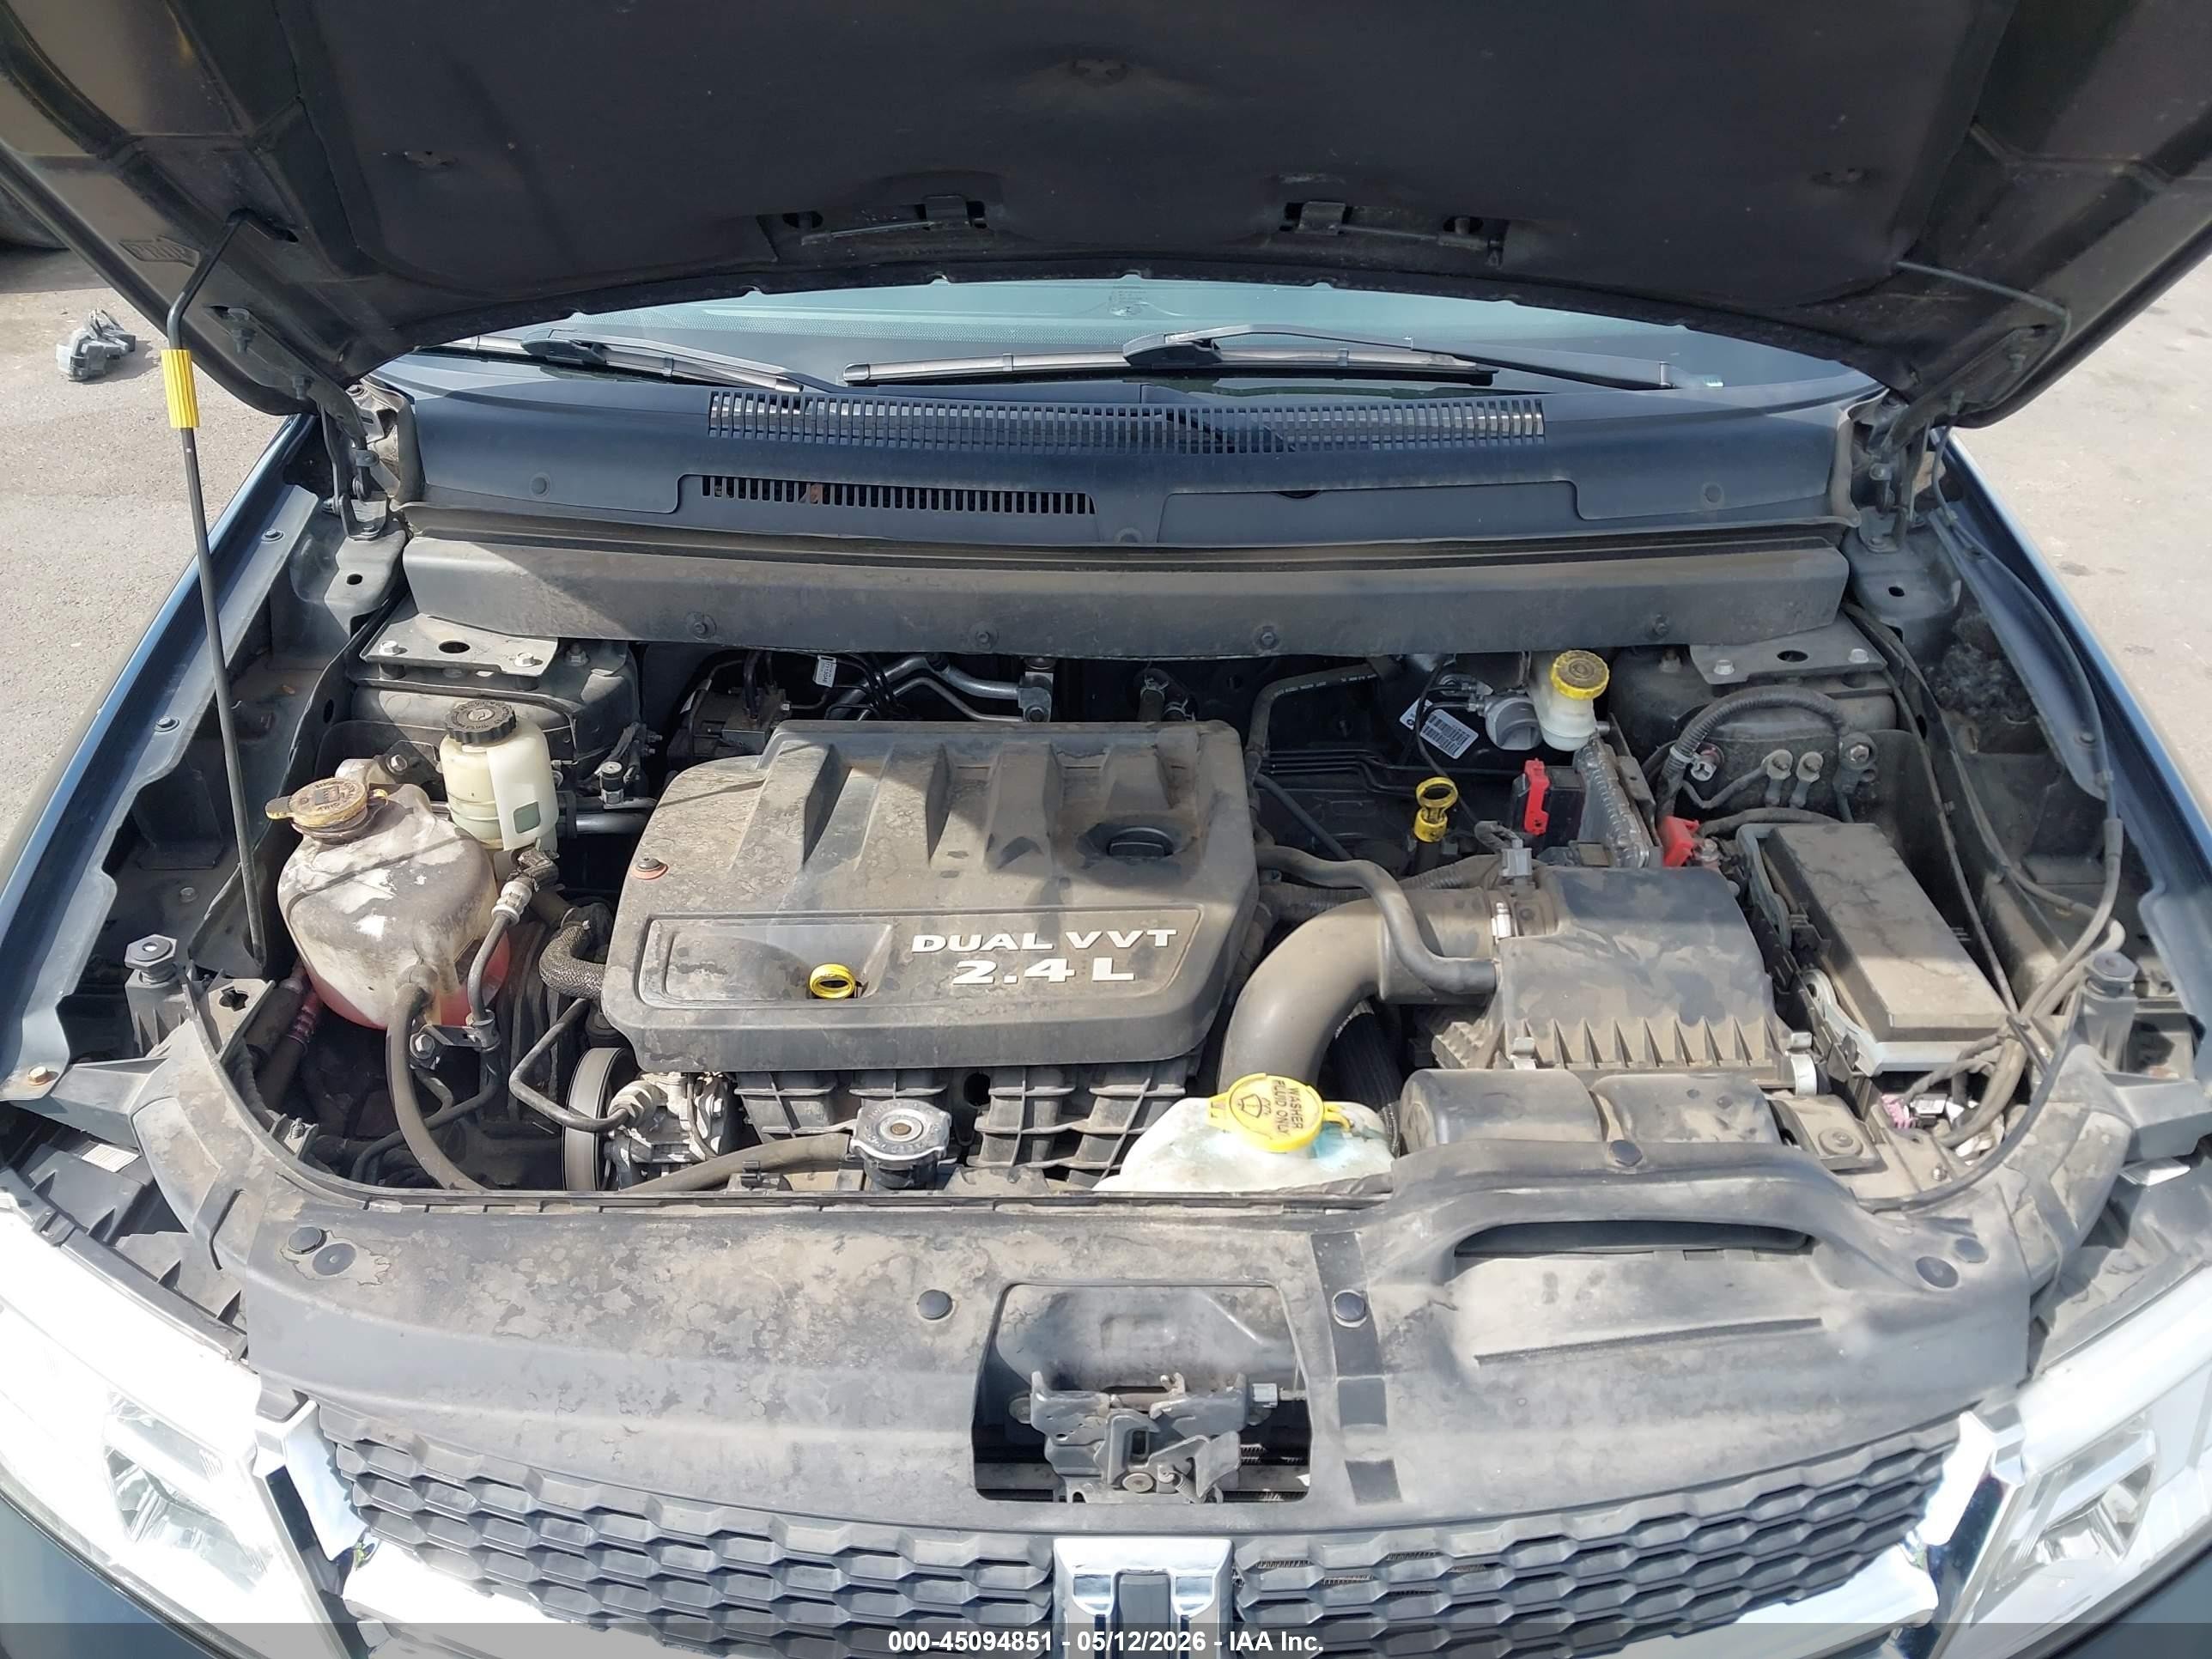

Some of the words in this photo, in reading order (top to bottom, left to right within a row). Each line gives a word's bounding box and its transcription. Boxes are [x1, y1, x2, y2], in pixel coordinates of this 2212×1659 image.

[912, 933, 1054, 953] DUAL
[1065, 929, 1177, 949] VVT
[1273, 1079, 1287, 1107] FLUID
[1288, 1087, 1304, 1129] WASHER
[1276, 1109, 1291, 1136] ONLY
